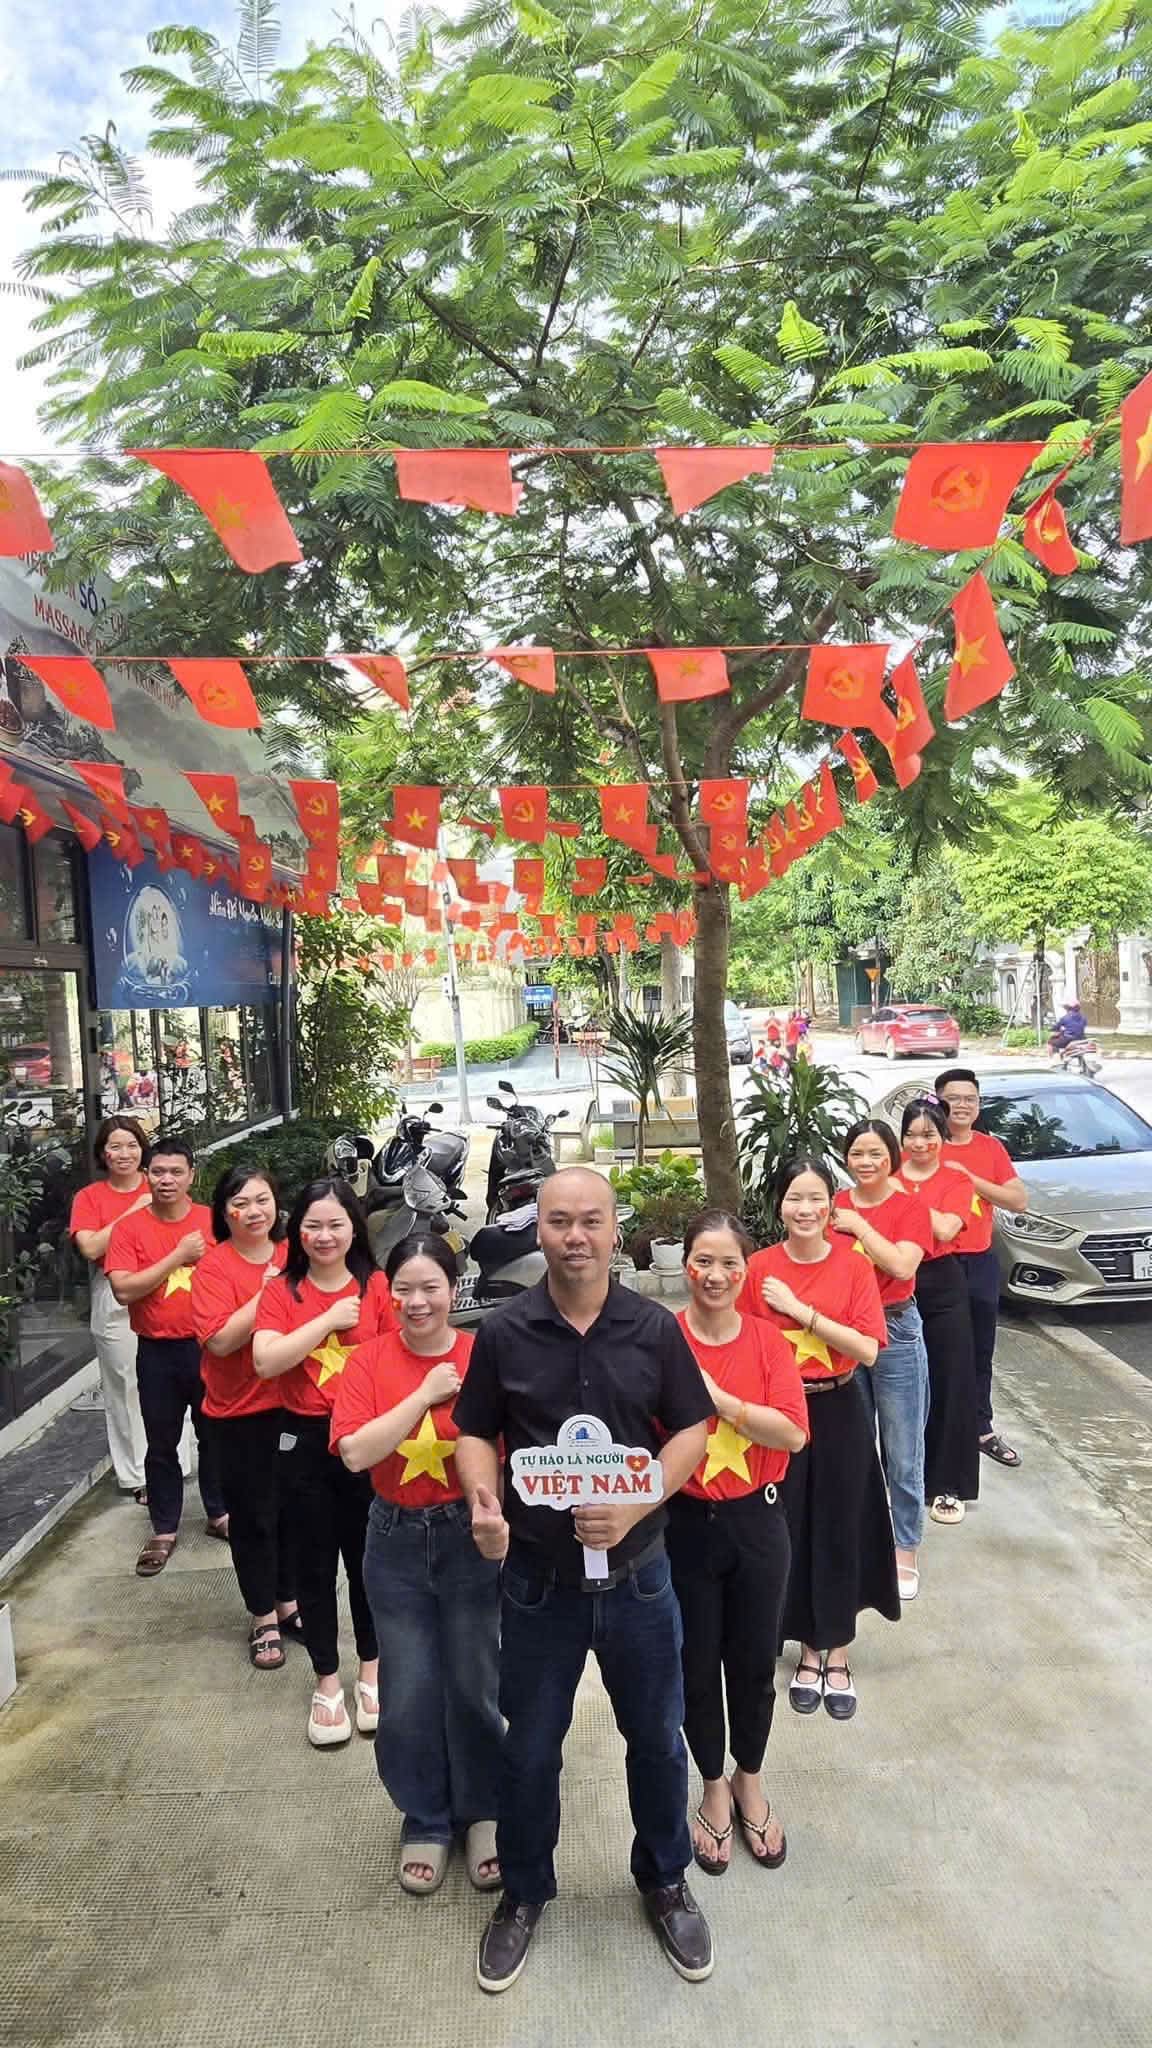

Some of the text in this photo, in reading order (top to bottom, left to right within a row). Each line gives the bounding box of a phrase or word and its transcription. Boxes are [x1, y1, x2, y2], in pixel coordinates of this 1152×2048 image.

[33, 593, 94, 655] MASSAGE
[520, 1451, 624, 1468] TỰ HÀO LÀ NGƯỜI
[521, 1470, 653, 1501] VIỆT NAM
